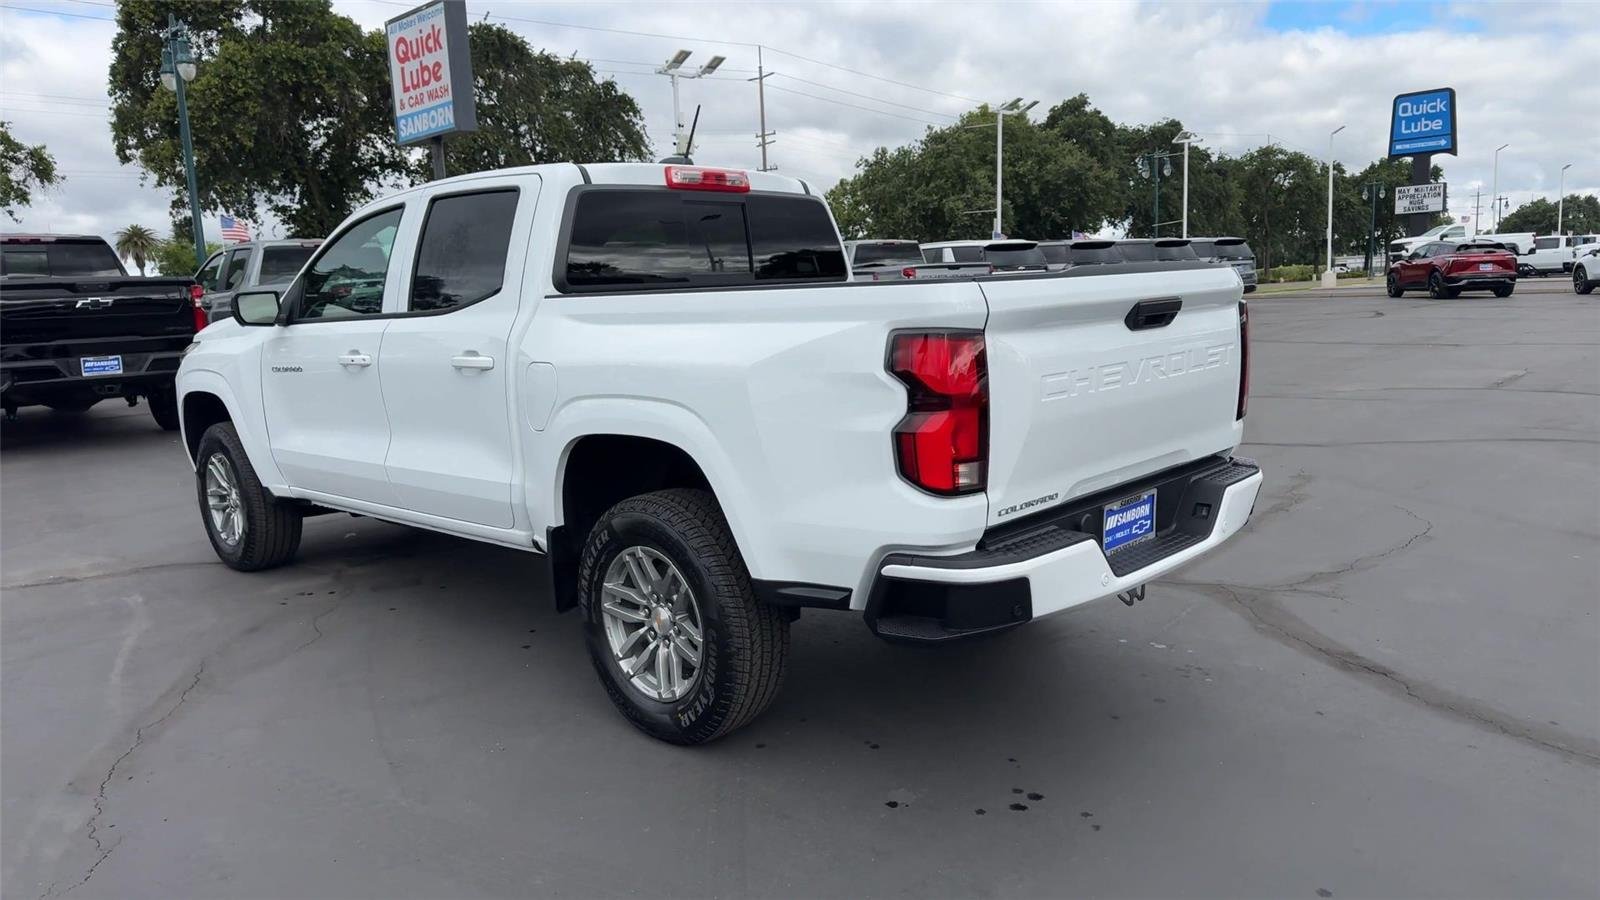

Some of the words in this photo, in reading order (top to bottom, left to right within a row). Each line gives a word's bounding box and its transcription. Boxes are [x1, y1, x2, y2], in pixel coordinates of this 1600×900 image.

[395, 24, 443, 64] Quick
[400, 60, 443, 94] Lube
[399, 99, 406, 111] &
[408, 92, 425, 109] CAR
[427, 84, 450, 102] WASH
[1398, 98, 1447, 117] Quick
[400, 105, 454, 138] SANBORN
[1401, 118, 1443, 134] Lube
[1397, 191, 1442, 201] APPRECIATION
[1040, 342, 1235, 402] CHEVROLET
[997, 492, 1059, 517] COLORADO
[1117, 503, 1151, 526] SANBORN
